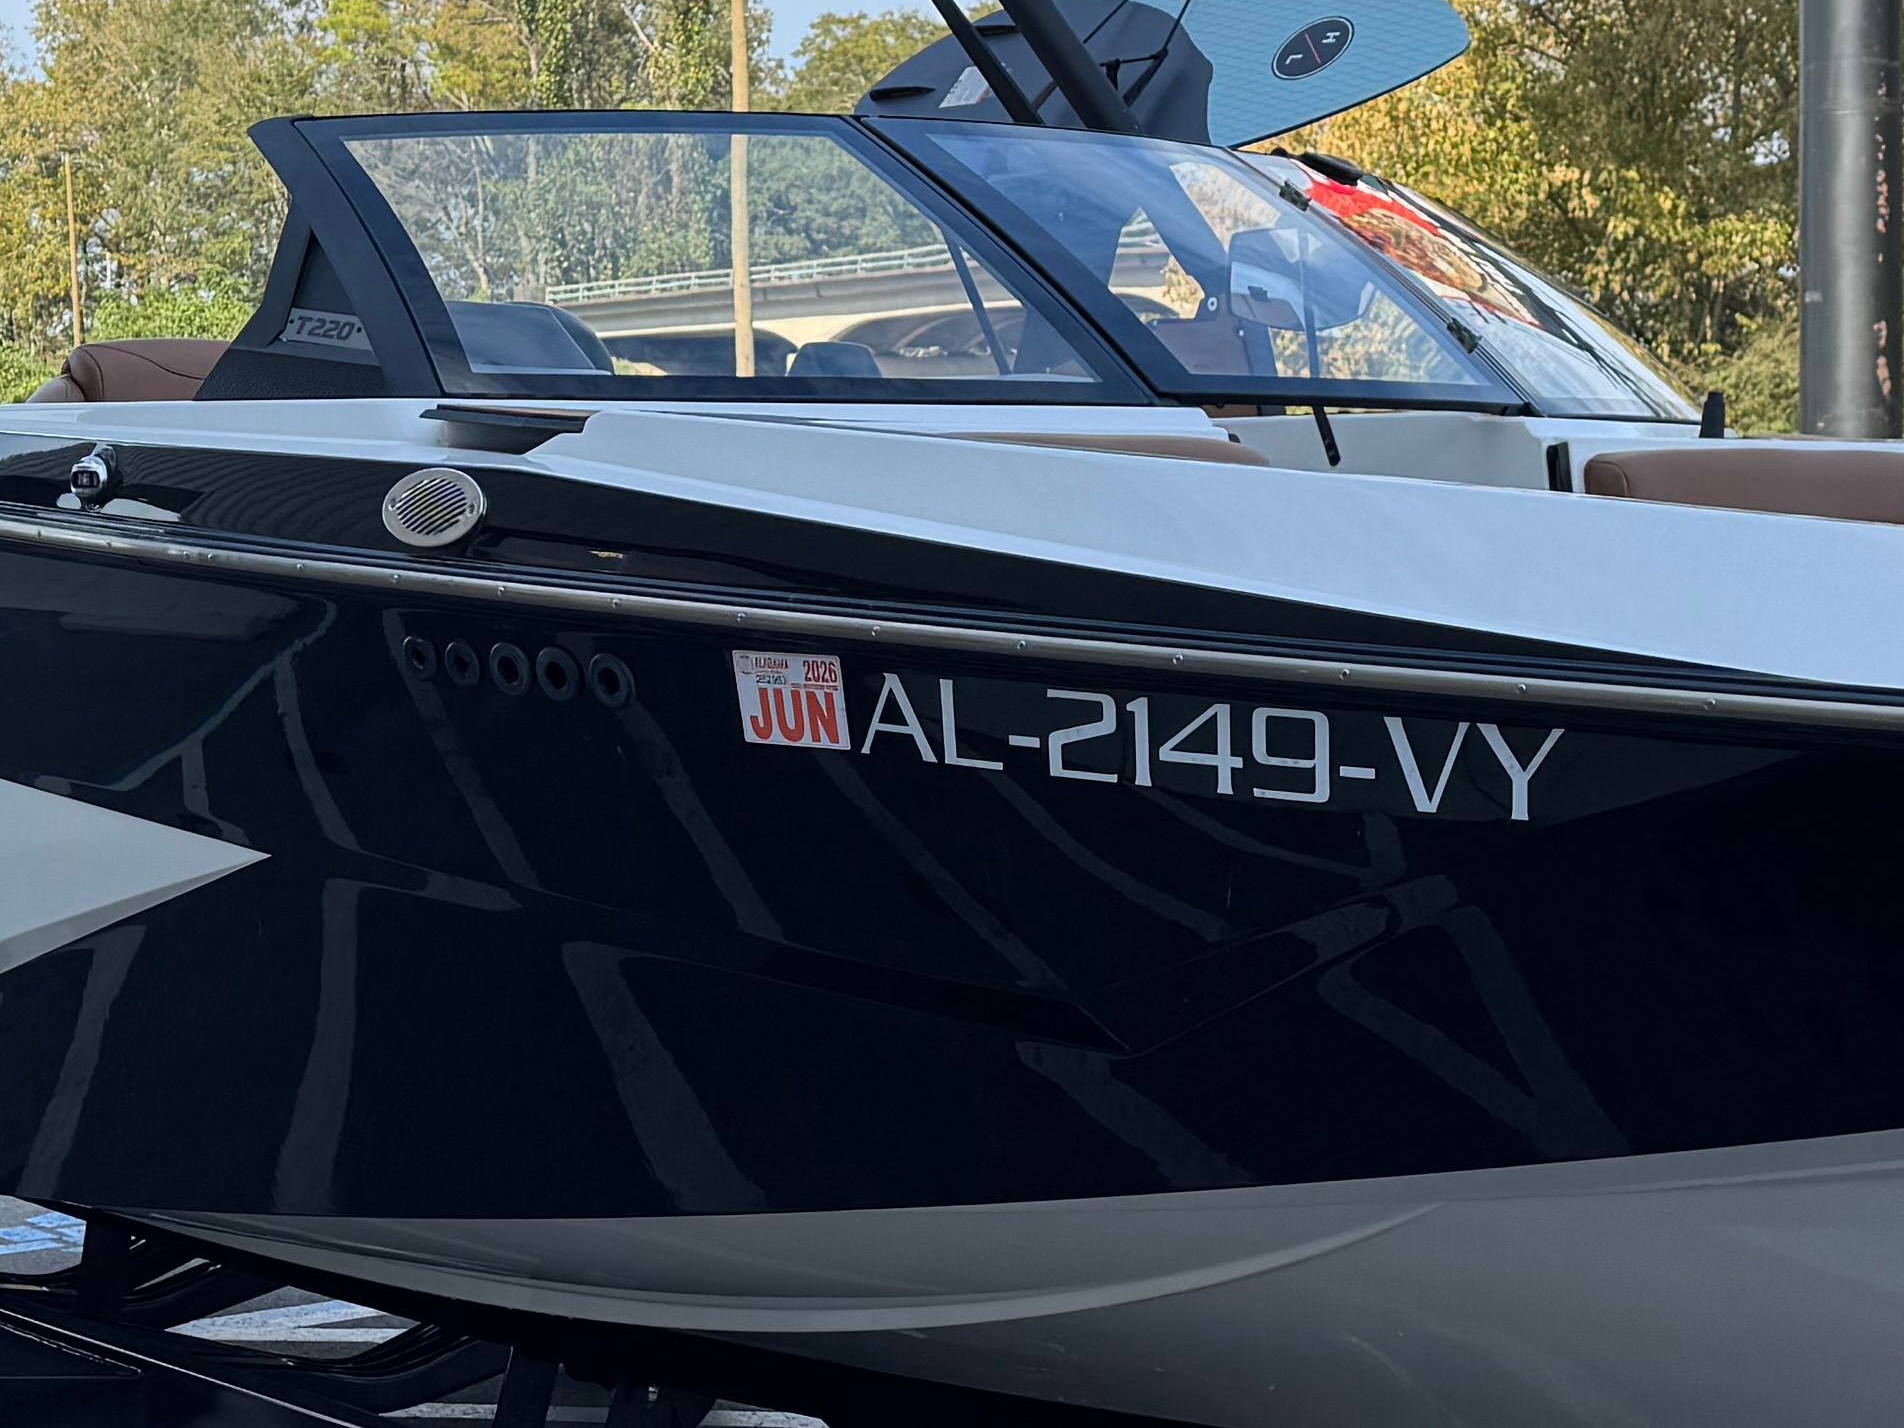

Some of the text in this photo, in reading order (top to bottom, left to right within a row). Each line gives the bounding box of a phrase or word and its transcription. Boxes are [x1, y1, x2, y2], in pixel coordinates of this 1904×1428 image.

[296, 315, 355, 341] T220
[803, 660, 838, 683] 2026
[750, 687, 840, 744] JUN
[860, 672, 1565, 821] AL-2149-VY
